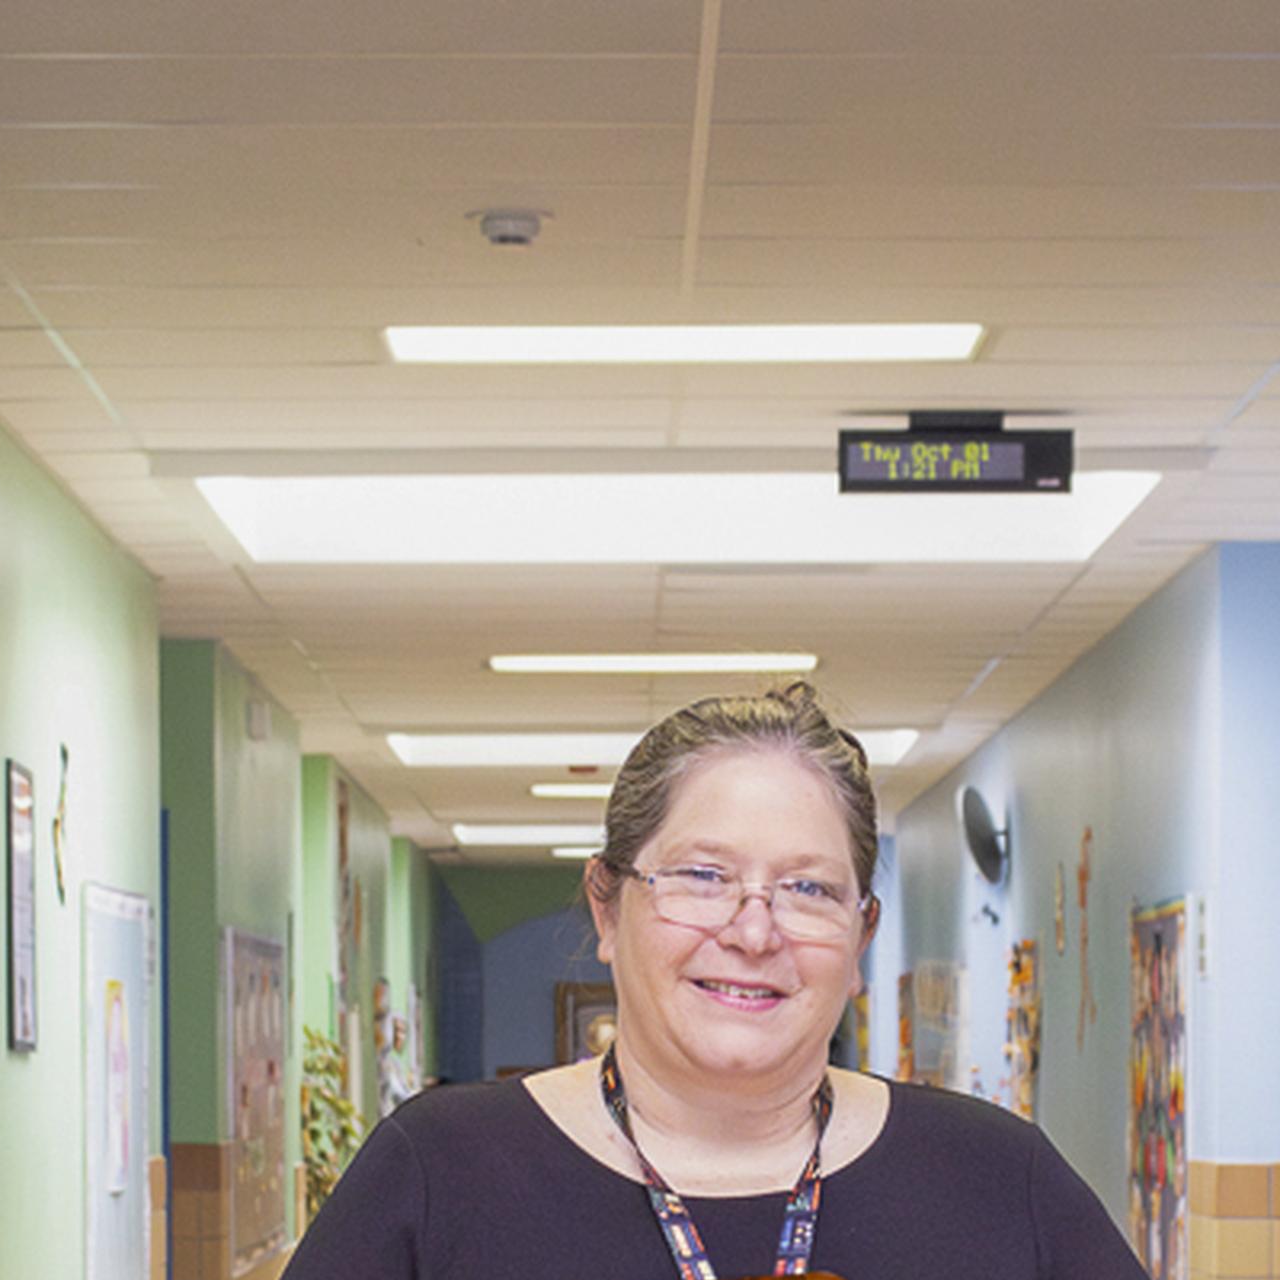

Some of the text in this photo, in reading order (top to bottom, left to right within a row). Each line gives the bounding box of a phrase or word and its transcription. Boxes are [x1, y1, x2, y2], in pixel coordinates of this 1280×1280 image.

[860, 442, 901, 462] Thu
[911, 442, 952, 462] Oct
[888, 460, 982, 480] 1:21 PM
